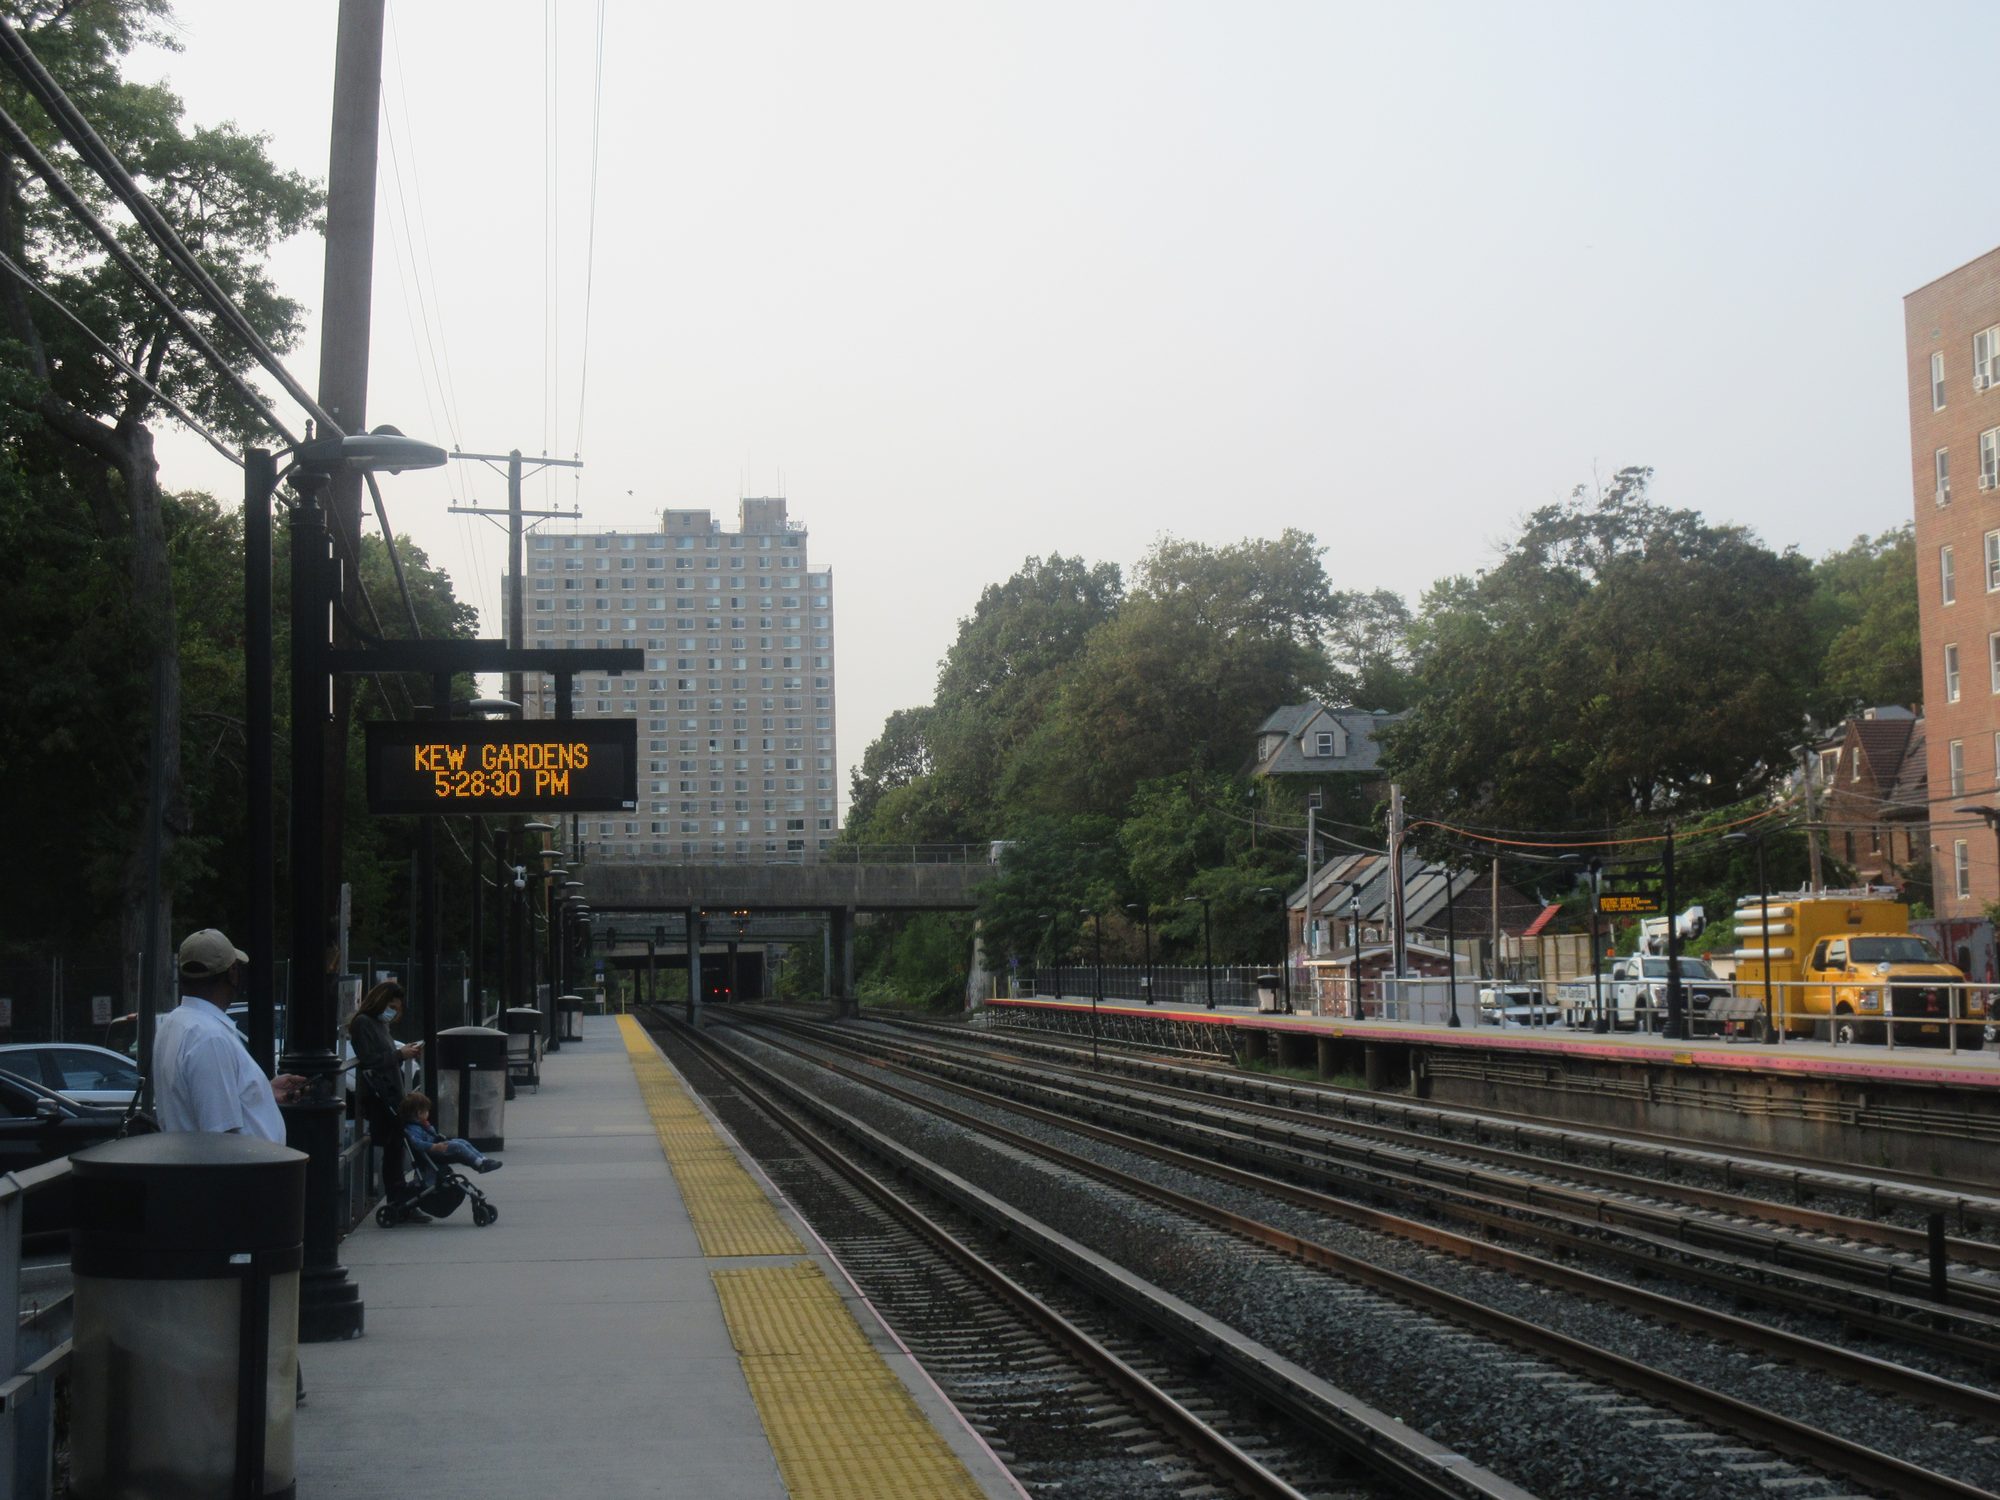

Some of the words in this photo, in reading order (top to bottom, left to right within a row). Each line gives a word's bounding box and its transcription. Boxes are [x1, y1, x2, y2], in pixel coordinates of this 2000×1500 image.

[414, 743, 467, 771] KEW
[481, 742, 589, 770] GARDENS
[435, 769, 521, 797] 5:28:30
[535, 769, 569, 796] PM
